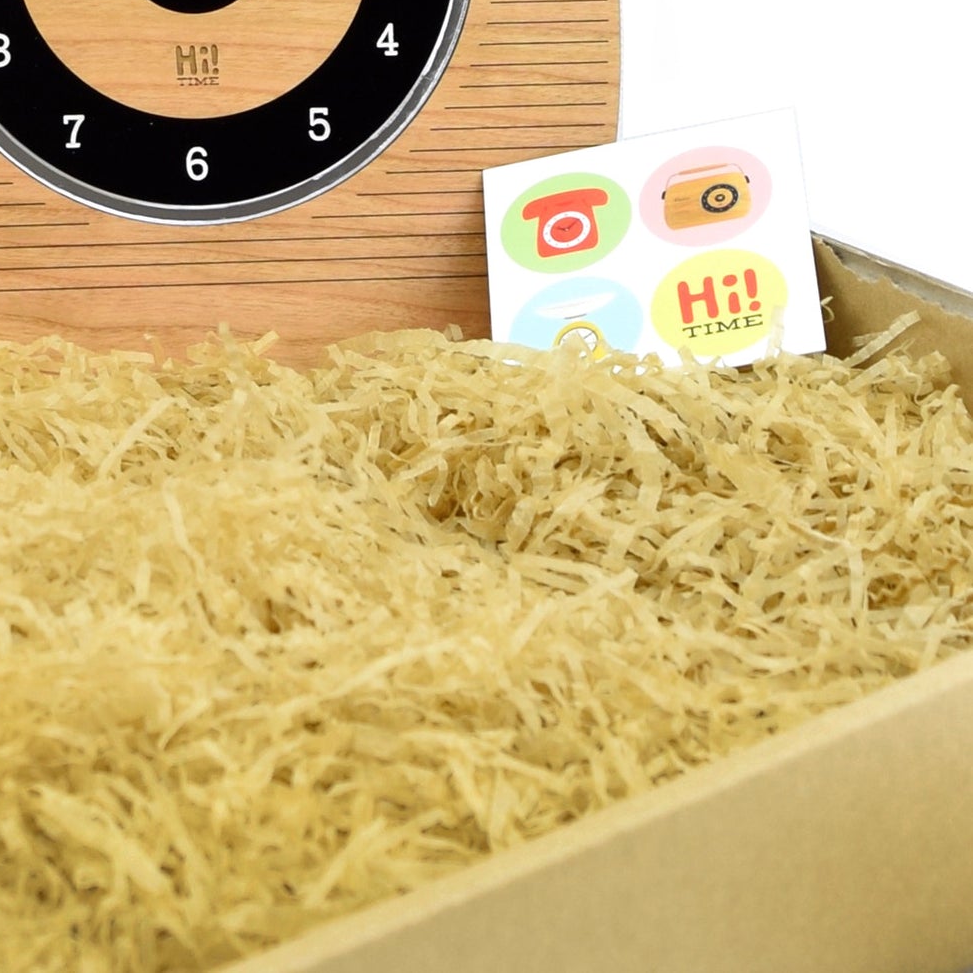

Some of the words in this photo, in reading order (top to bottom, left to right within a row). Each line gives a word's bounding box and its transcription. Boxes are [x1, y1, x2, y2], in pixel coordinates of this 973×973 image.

[376, 23, 399, 57] 4
[176, 44, 219, 76] Hi!
[177, 77, 219, 86] TIME
[63, 115, 85, 148] 7
[308, 107, 331, 142] 5
[186, 147, 209, 181] 6
[677, 268, 762, 325] Hi!
[682, 314, 764, 338] TIME
